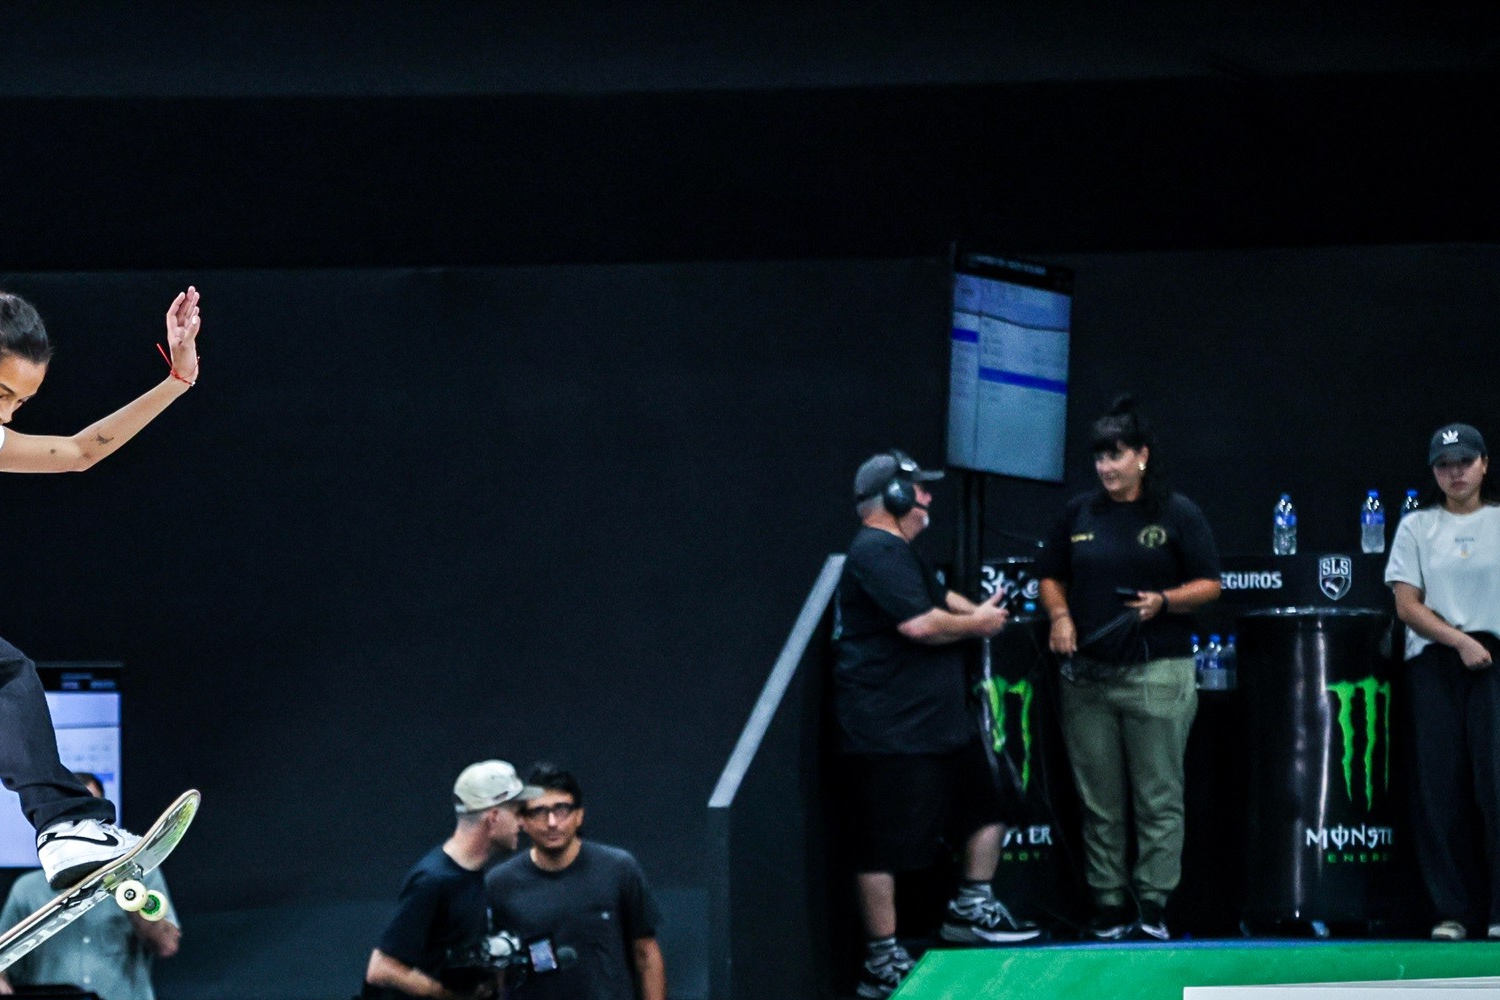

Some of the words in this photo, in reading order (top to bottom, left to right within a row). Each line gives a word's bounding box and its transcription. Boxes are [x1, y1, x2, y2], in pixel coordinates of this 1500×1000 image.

[1322, 559, 1349, 576] SLS
[1220, 572, 1283, 589] EGUROS
[1305, 823, 1392, 850] MONST
